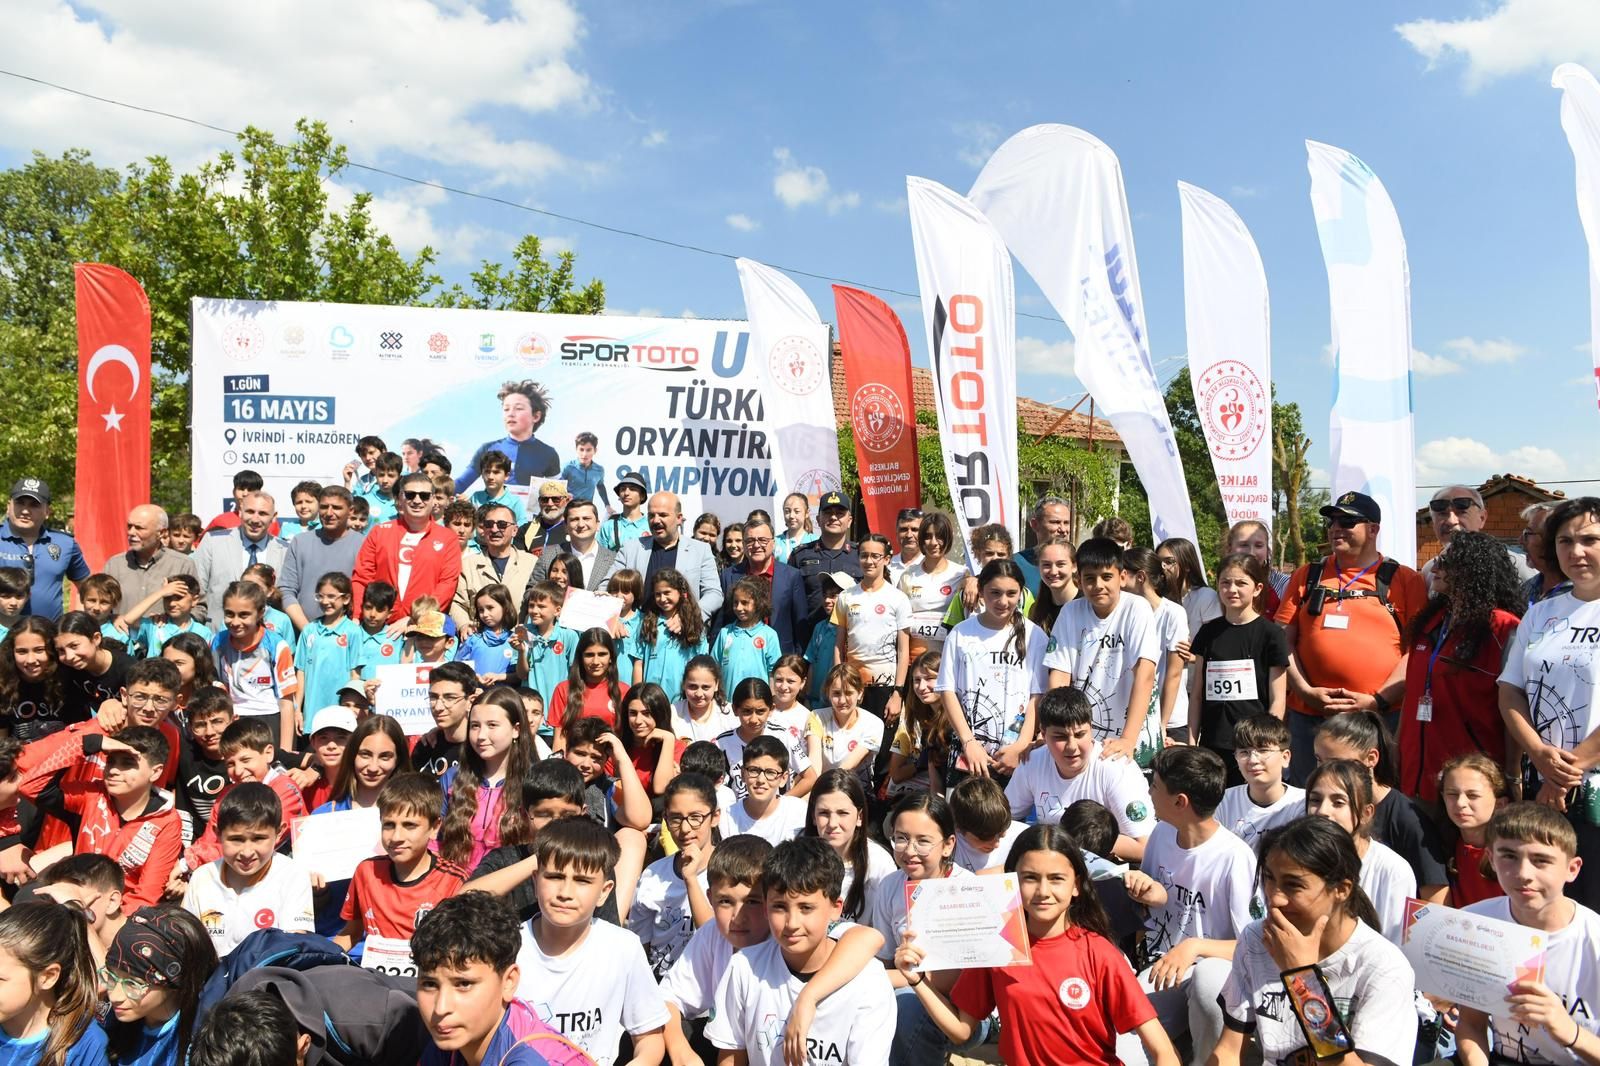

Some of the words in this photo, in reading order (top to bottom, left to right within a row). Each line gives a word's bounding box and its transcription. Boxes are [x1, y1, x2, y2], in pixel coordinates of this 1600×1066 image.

[230, 376, 261, 391] 1.GÜN
[231, 400, 254, 420] 16
[261, 400, 328, 421] MAYIS
[242, 429, 285, 444] İVRİNDİ
[297, 430, 361, 445] KİRAZÖREN
[242, 452, 271, 465] SAAT
[275, 452, 305, 466] 11.00
[918, 625, 939, 637] 437
[401, 687, 430, 698] DEM
[1214, 680, 1242, 694] 591
[805, 1037, 843, 1063] RiA
